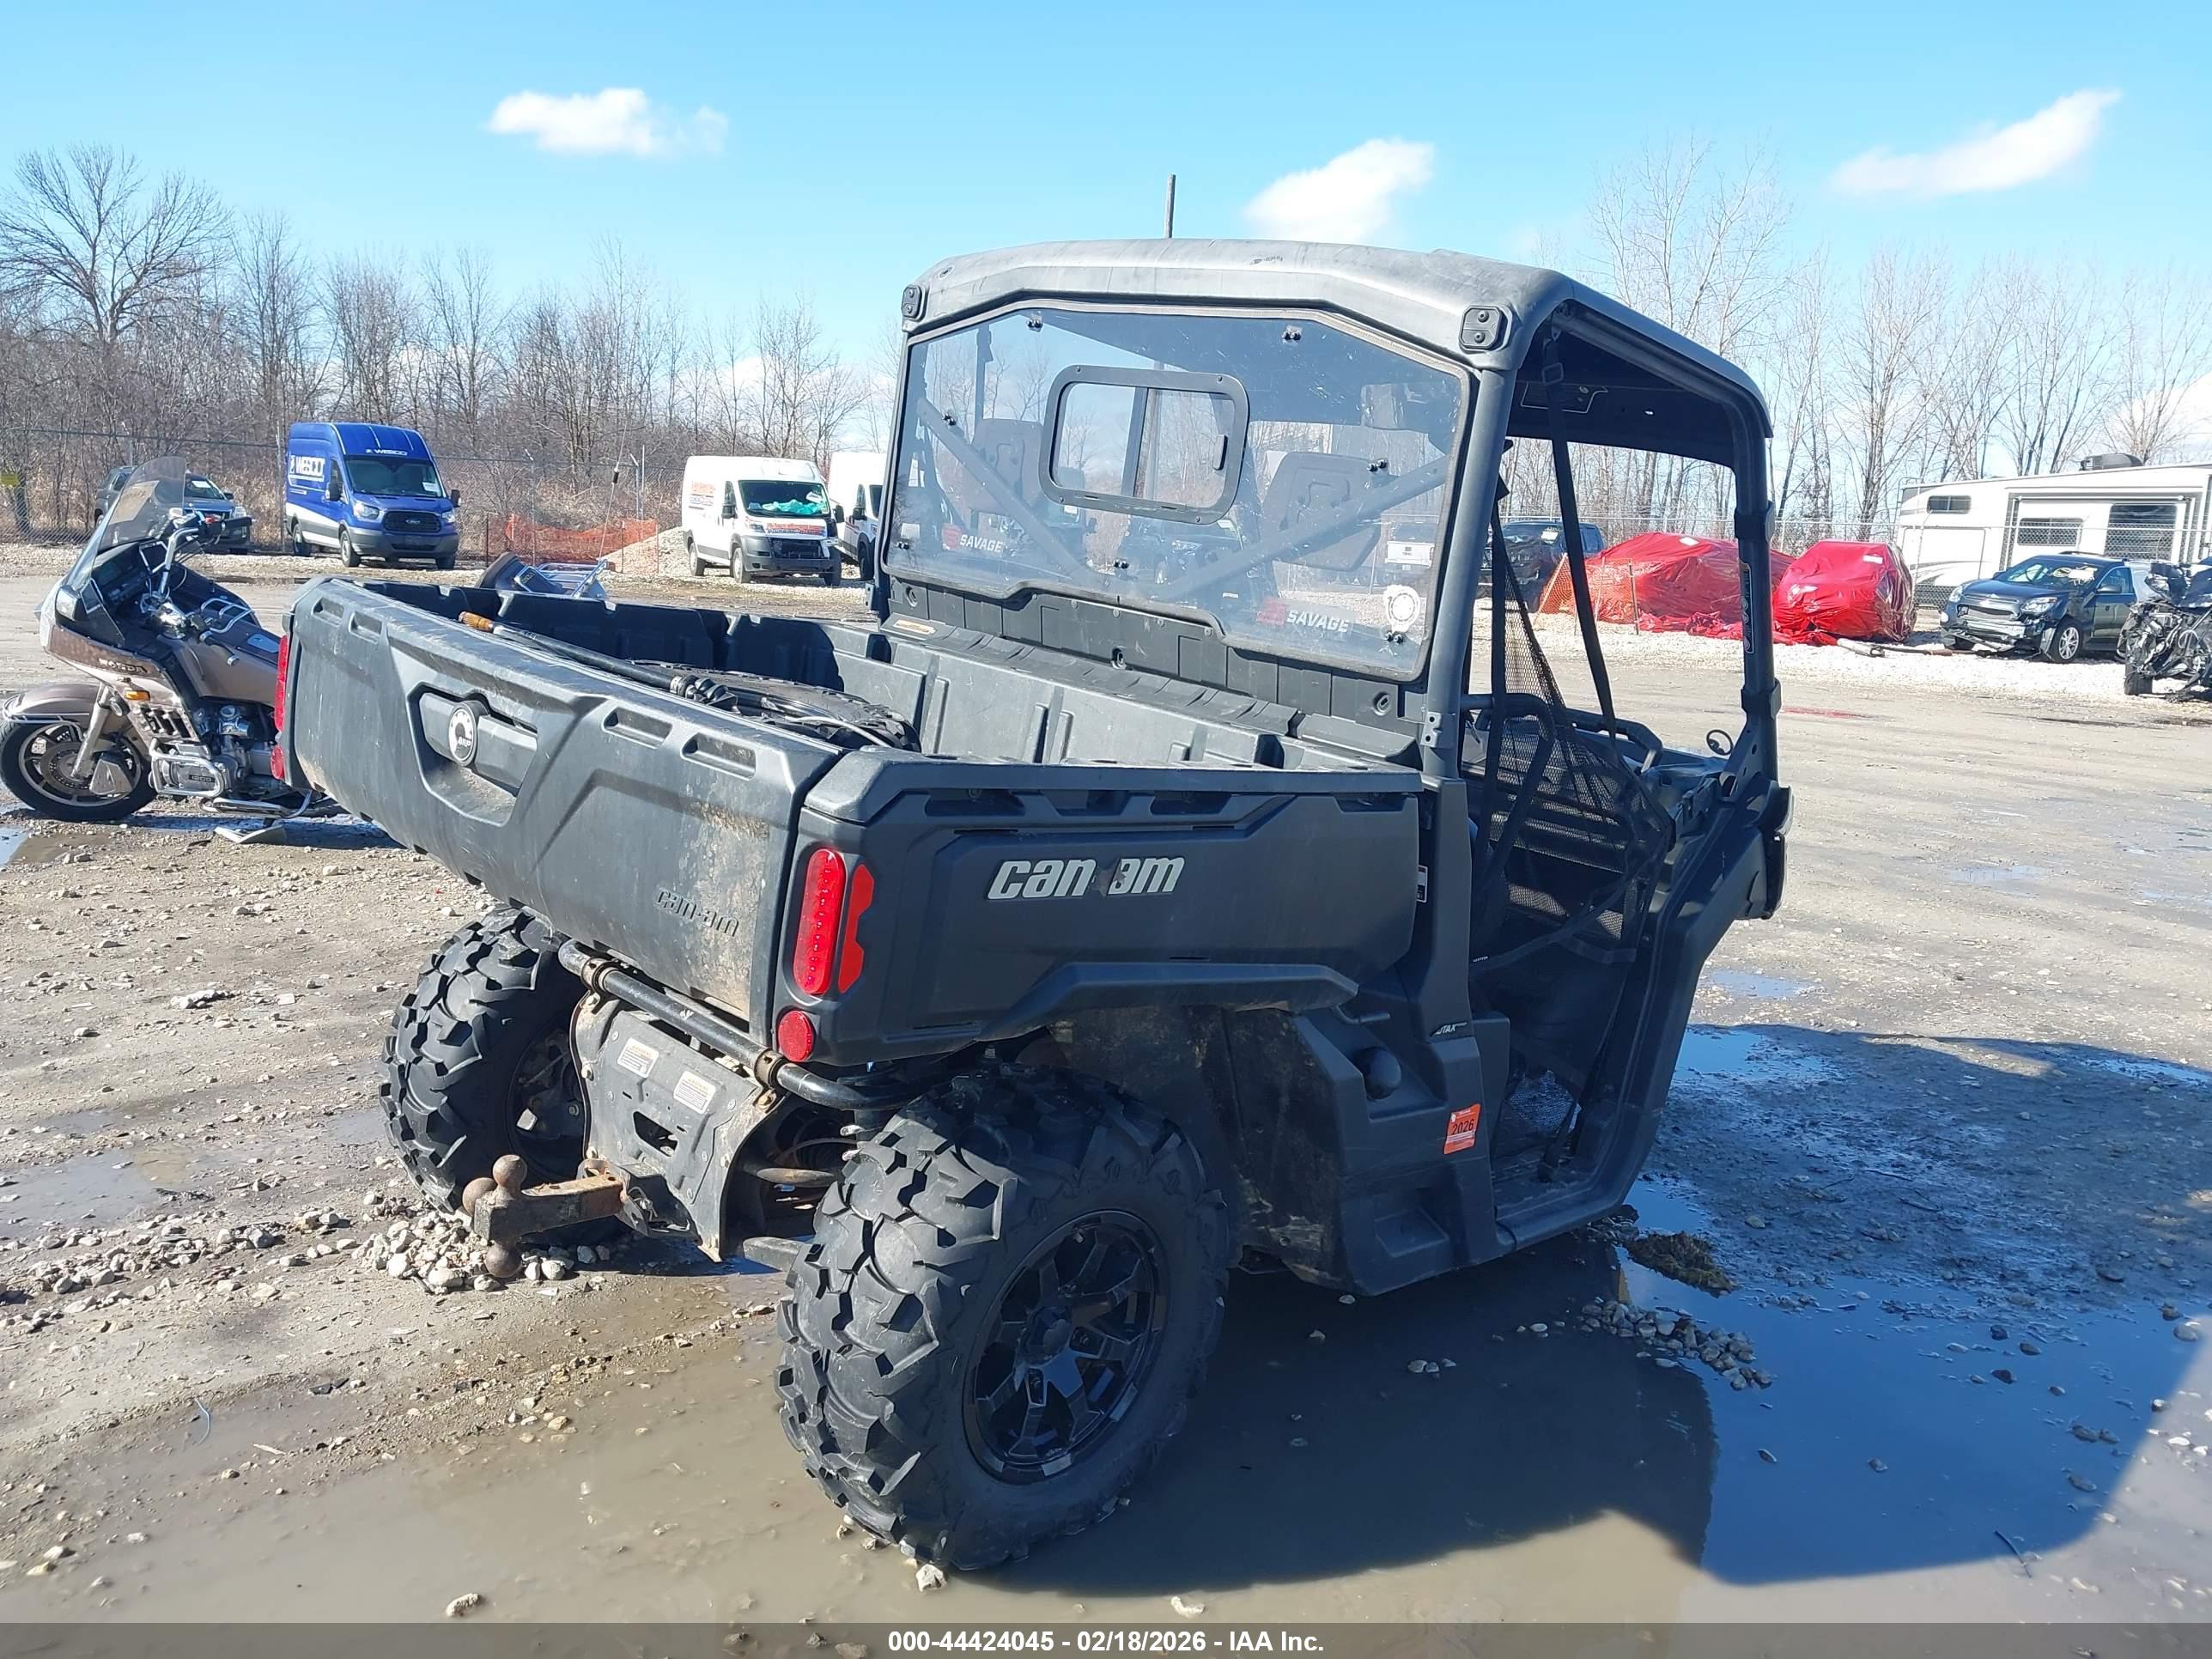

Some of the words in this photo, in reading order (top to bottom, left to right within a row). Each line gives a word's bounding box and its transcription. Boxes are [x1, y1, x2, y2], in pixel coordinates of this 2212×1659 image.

[959, 533, 1004, 554] SAVAGE
[1285, 609, 1350, 634] SAVAGE
[98, 657, 148, 674] HONDA
[988, 856, 1185, 900] canam
[653, 887, 740, 938] can-am
[1452, 1118, 1475, 1135] 2026
